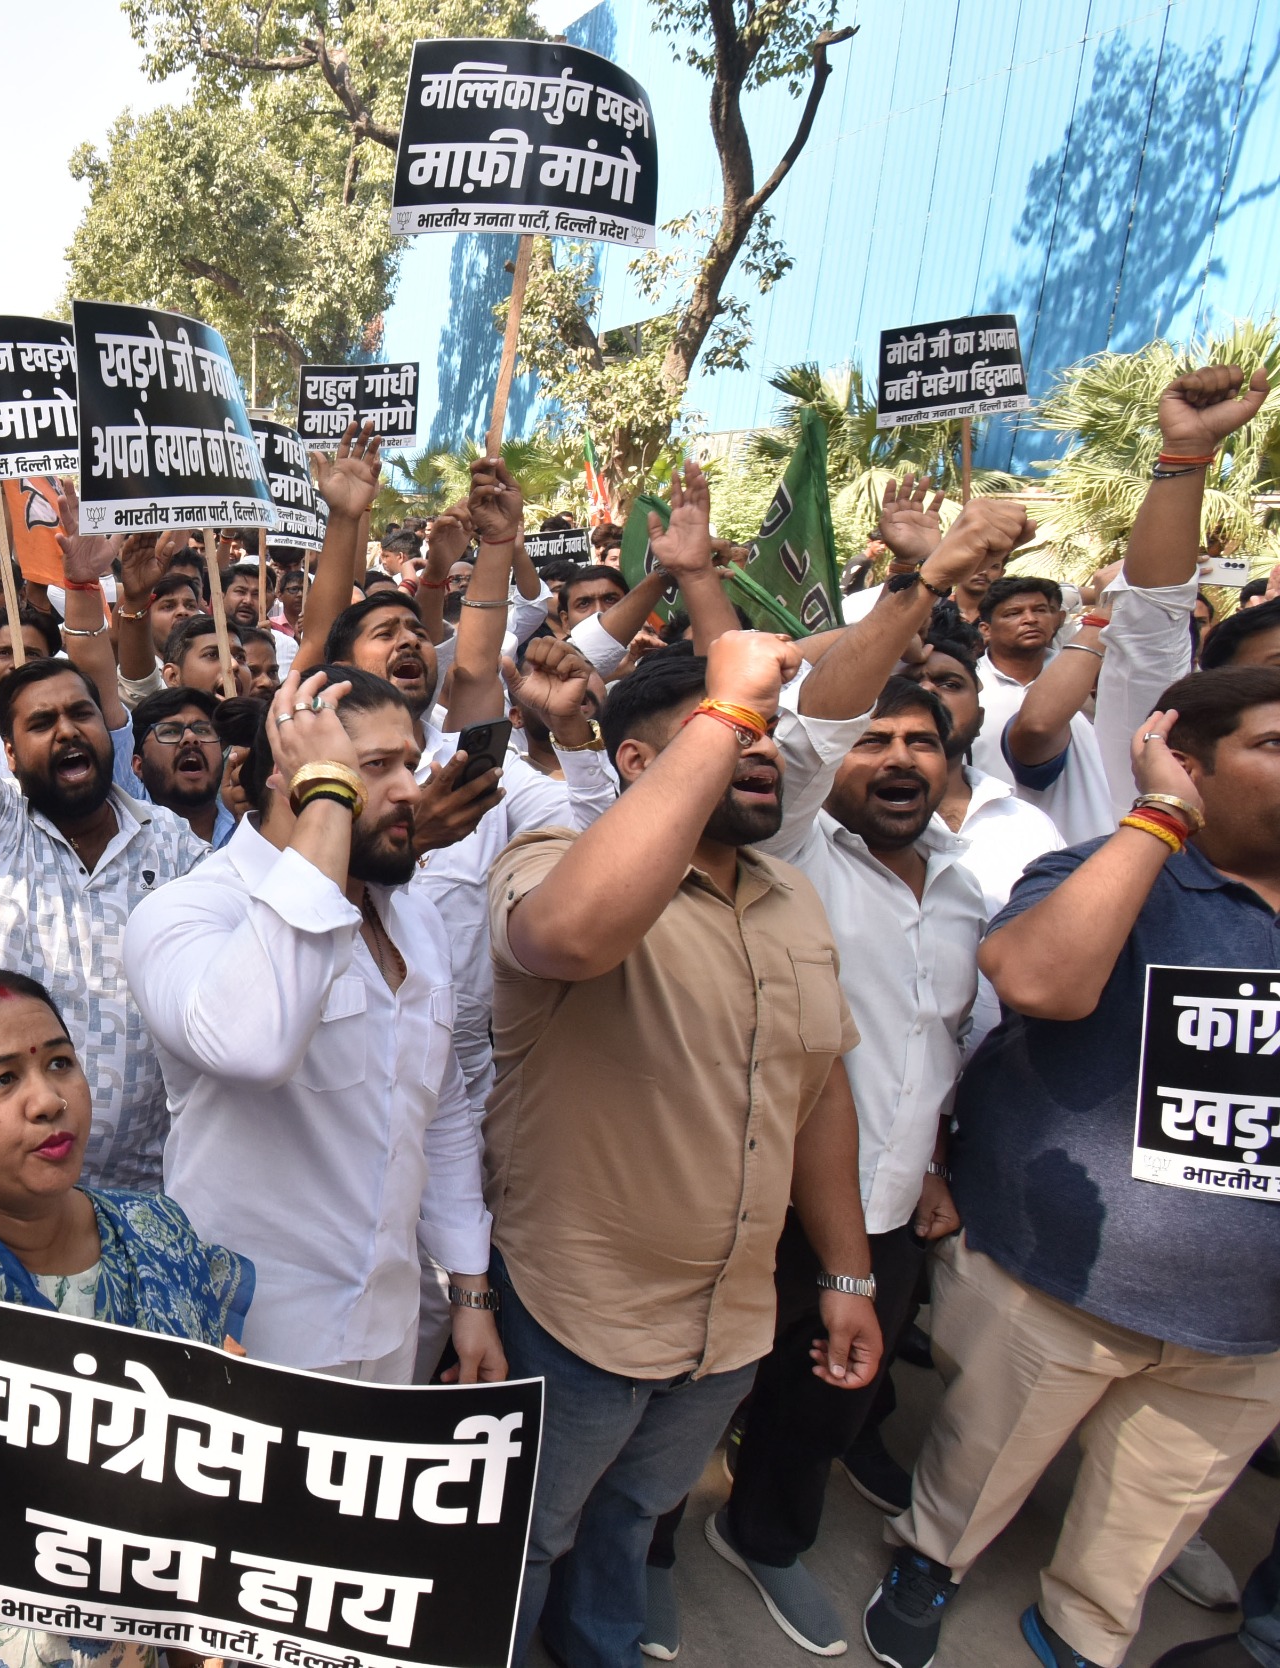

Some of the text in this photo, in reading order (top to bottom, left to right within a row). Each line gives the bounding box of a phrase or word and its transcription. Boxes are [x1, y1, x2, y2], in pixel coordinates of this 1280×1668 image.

[420, 61, 649, 139] मल्लिकार्जुन खड़गे
[407, 128, 641, 204] माफ़ी मांगो
[417, 208, 629, 240] भारतीय जनता पार्टी, दिल्ली प्रदेश
[95, 320, 167, 403] खड़गे
[167, 327, 198, 393] जी
[886, 328, 1017, 365] मोदी जी का अपमान
[305, 365, 417, 406] राहुल गांधी
[884, 358, 1023, 402] नहीं सहेगा हिंदुस्तान
[359, 400, 415, 432] मांगो
[895, 399, 1017, 423] भारतीय जनता पार्टी, दिल्ली प्रदेश
[91, 409, 149, 479] अपने
[151, 425, 206, 477] बयान
[202, 428, 229, 477] का
[308, 441, 330, 449] भारतीय
[386, 438, 402, 447] प्रदेश
[15, 454, 51, 473] दिल्ली
[269, 470, 312, 508] मांगो
[114, 503, 170, 526] भारतीय
[172, 506, 207, 522] जनता
[209, 501, 232, 523] पार्टी,
[233, 501, 258, 521] दिल्ली
[549, 534, 564, 556] पार्टी
[1183, 1165, 1271, 1192] भारतीय
[297, 1412, 523, 1525] पार्टी
[25, 1508, 434, 1648] हाय हाय
[0, 1598, 104, 1633] भारतीय
[111, 1614, 195, 1643] जनता
[200, 1630, 265, 1660] पार्टी,
